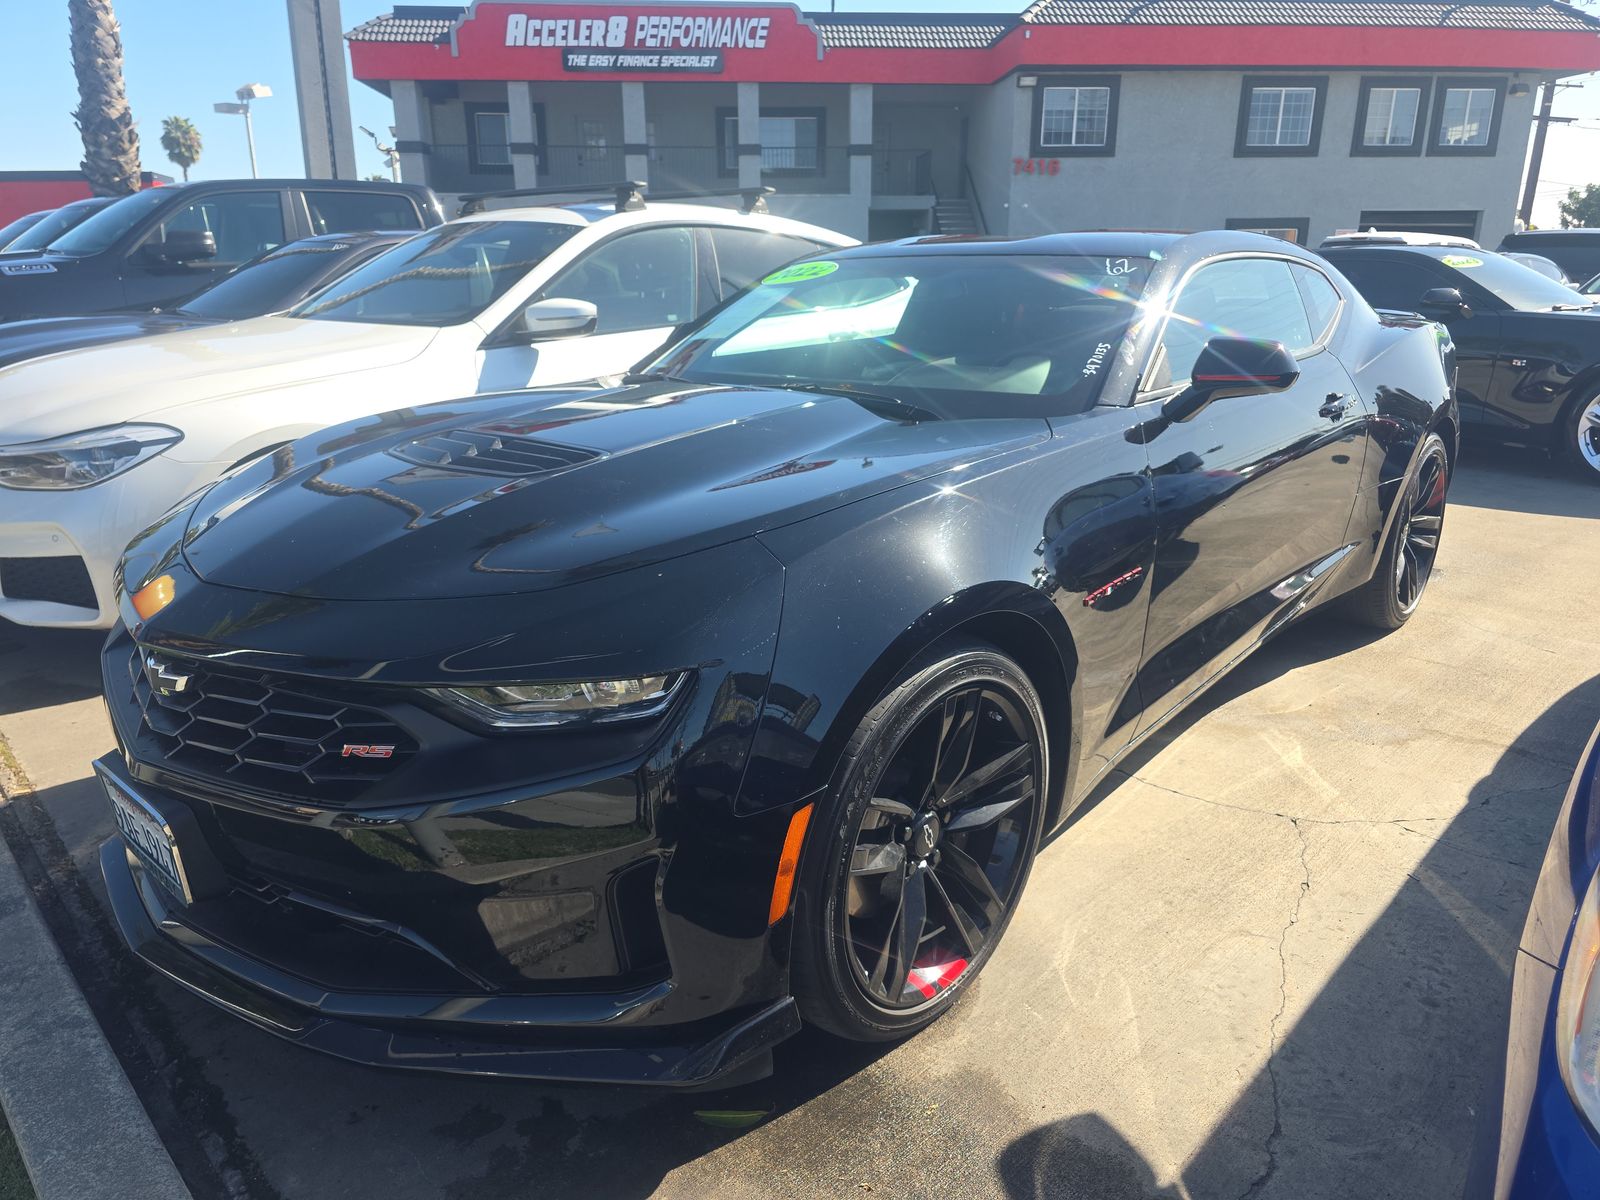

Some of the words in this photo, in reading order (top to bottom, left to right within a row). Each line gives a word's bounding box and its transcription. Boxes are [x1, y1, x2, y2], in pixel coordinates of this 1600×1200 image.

[505, 14, 628, 48] ACCELER8
[633, 16, 770, 49] PERFORMANCE
[567, 54, 587, 67] THE
[588, 54, 616, 68] EASY
[618, 55, 660, 68] FINANCE
[661, 55, 717, 68] SPECIALIST
[342, 744, 395, 758] RS
